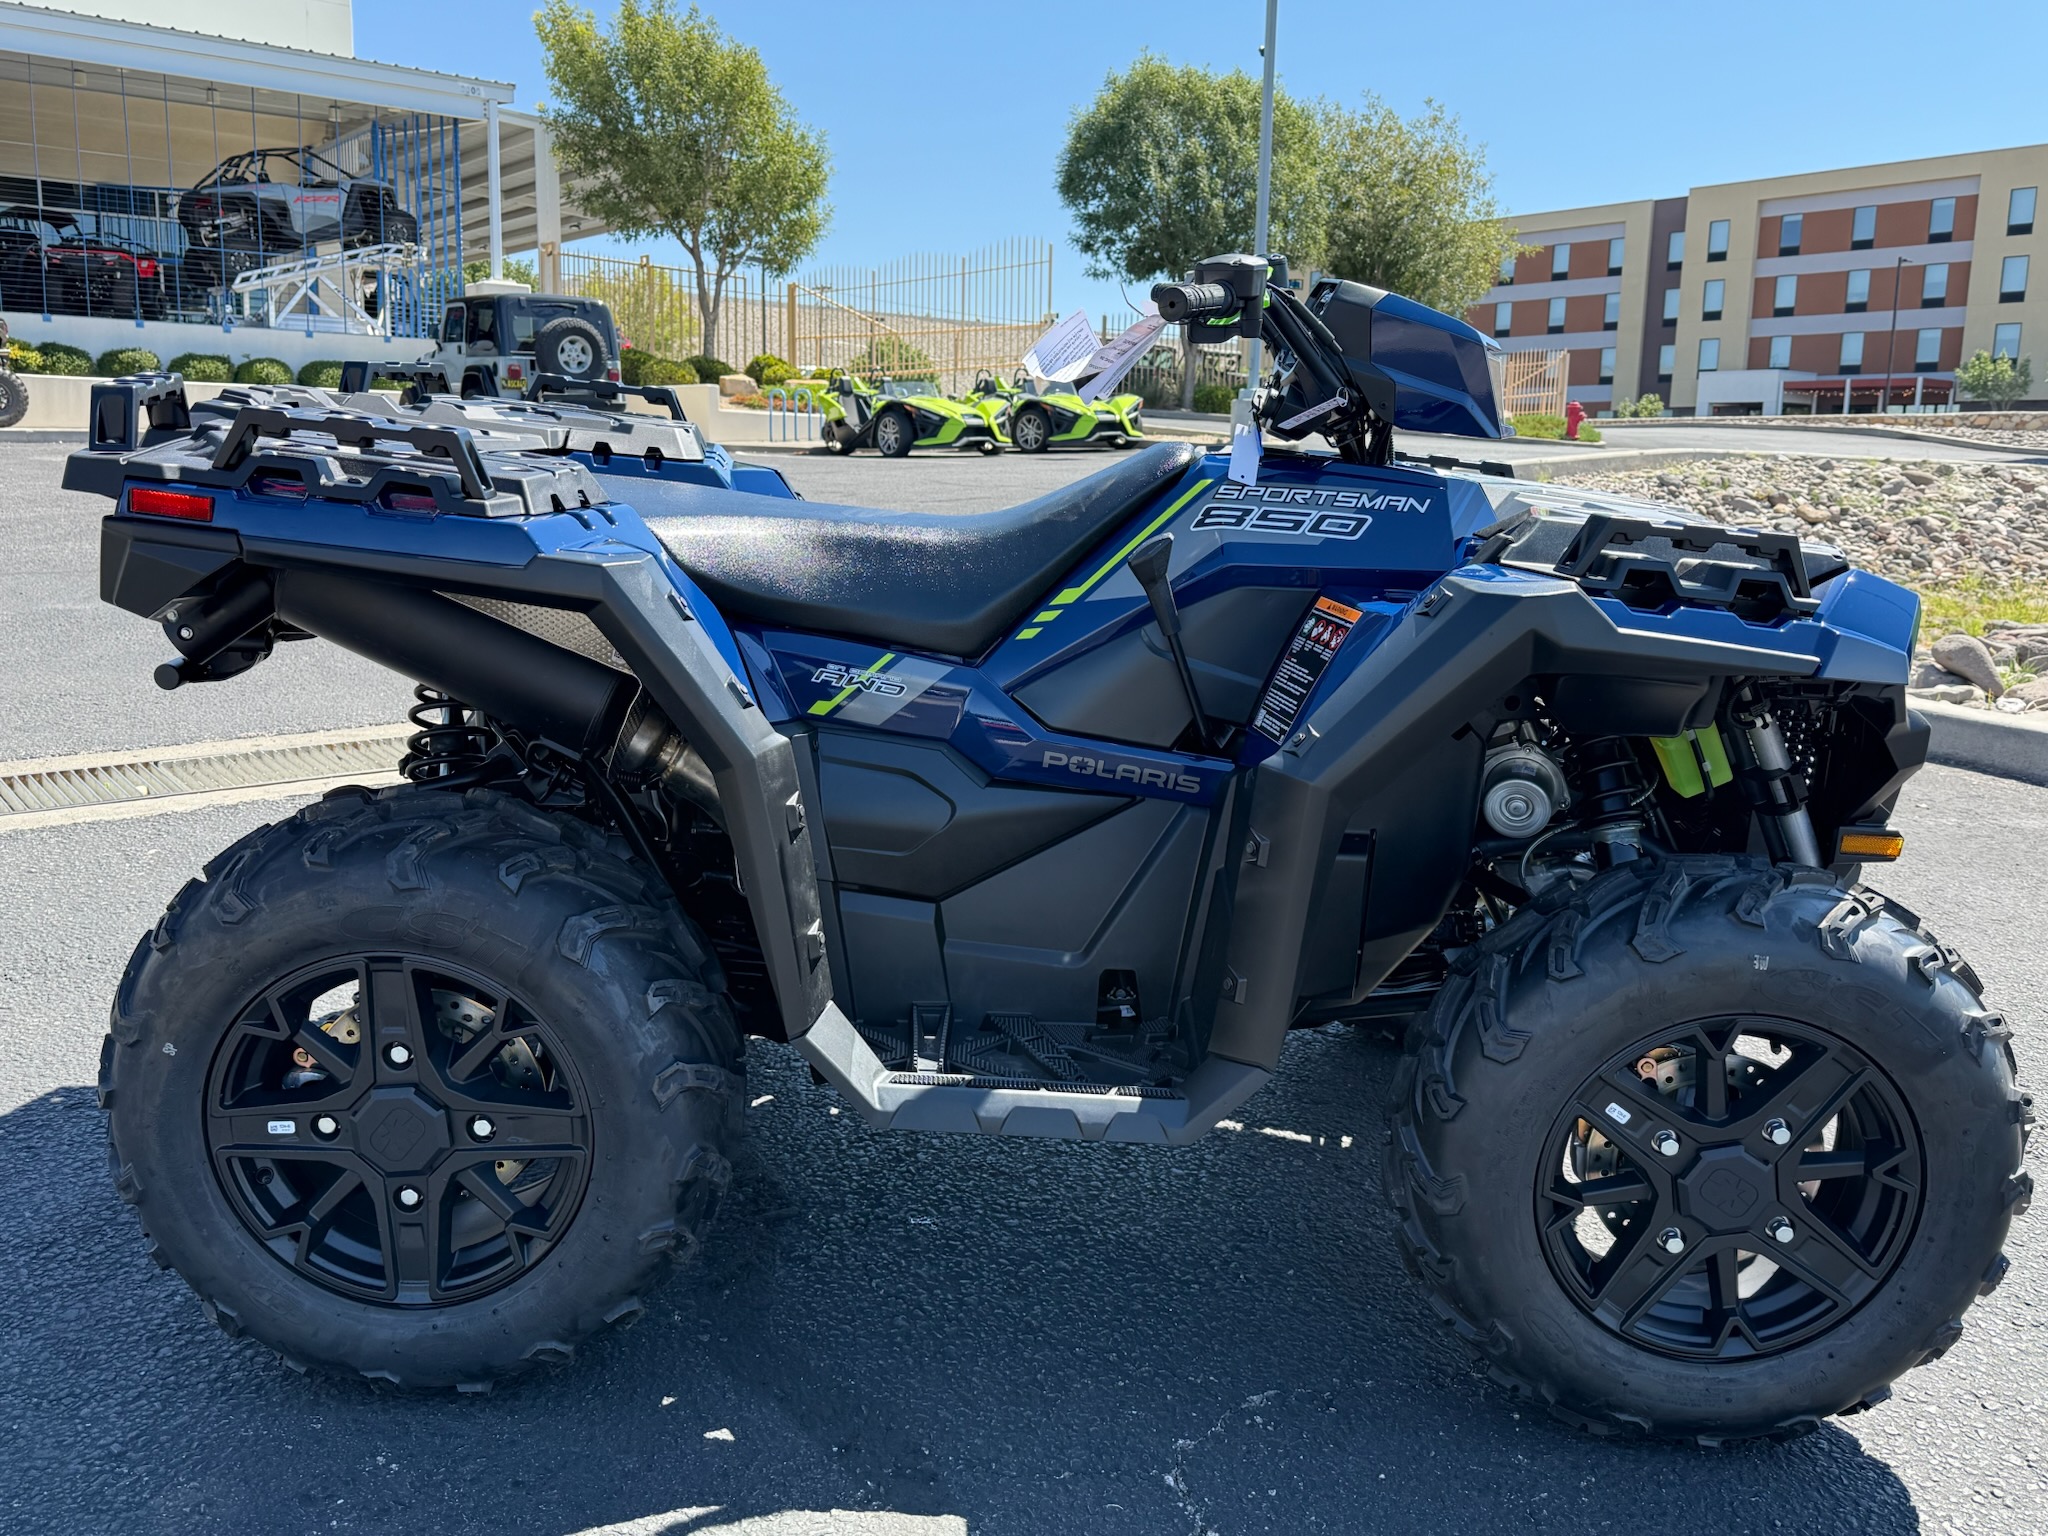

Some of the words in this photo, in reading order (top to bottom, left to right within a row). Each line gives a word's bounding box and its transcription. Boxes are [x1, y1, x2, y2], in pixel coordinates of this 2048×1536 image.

[1214, 484, 1432, 514] SPORTSMAN
[1190, 504, 1373, 540] 850
[811, 668, 907, 698] AWD
[1042, 750, 1201, 794] POLARIS
[339, 904, 528, 967] CST
